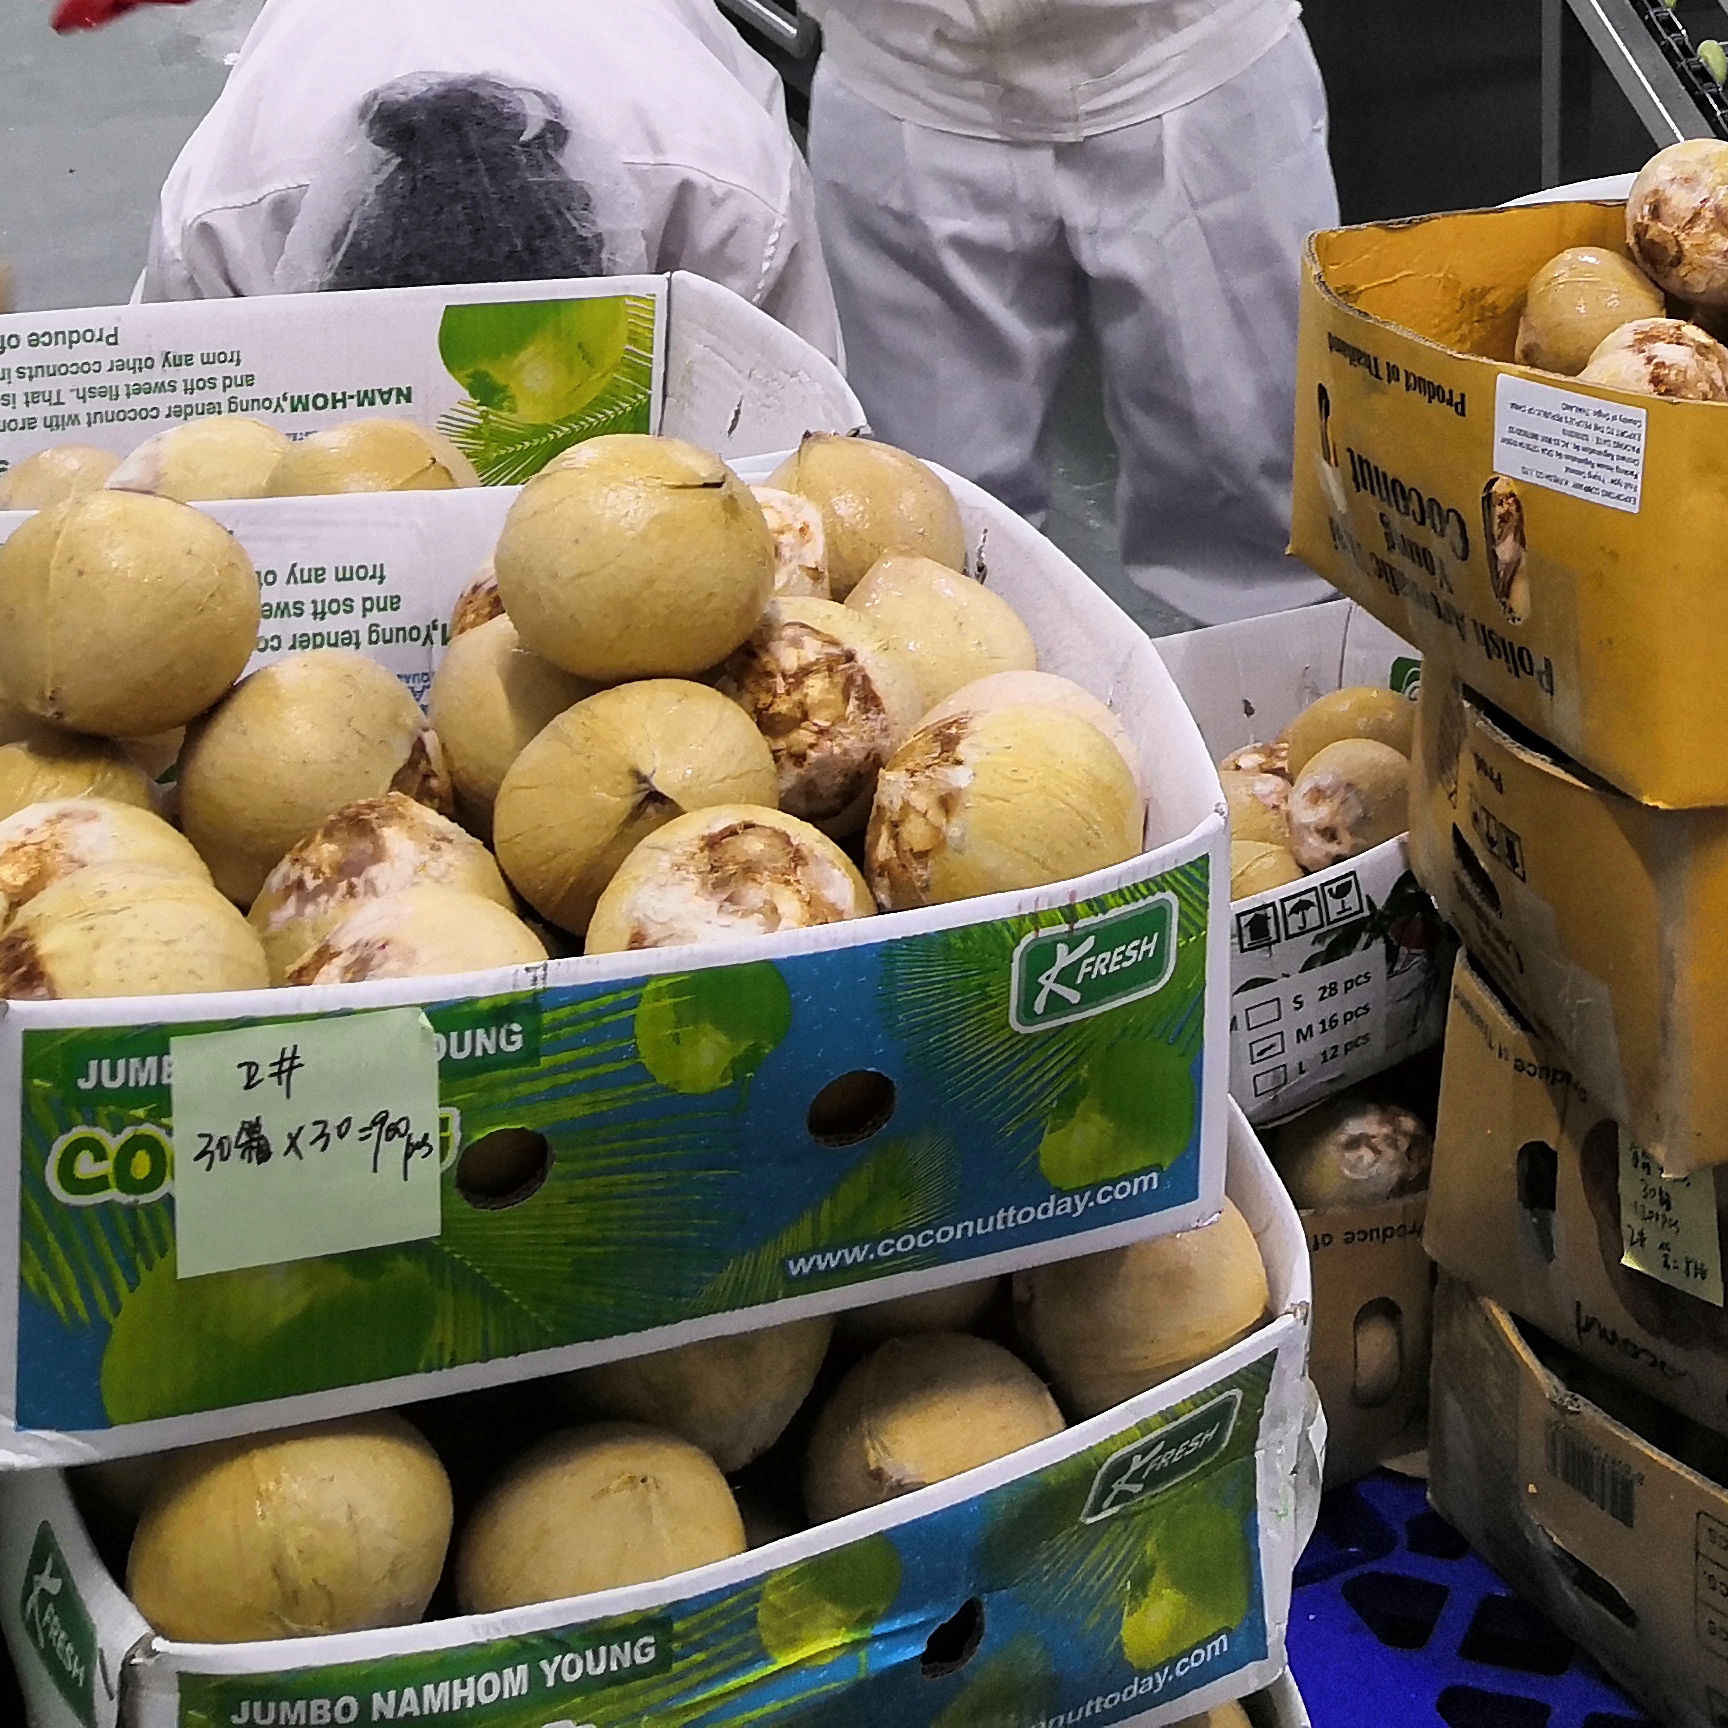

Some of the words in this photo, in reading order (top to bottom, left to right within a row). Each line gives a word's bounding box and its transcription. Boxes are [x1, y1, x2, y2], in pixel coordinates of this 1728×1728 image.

[27, 326, 119, 350] Produce
[16, 359, 102, 382] coconuts
[106, 356, 155, 374] other
[161, 350, 196, 370] any
[200, 350, 242, 368] from
[124, 379, 178, 399] sweet
[183, 376, 218, 397] soft
[221, 373, 256, 390] and
[0, 393, 17, 410] is
[24, 388, 66, 408] That
[1404, 369, 1466, 418] Product
[86, 405, 161, 428] coconut
[165, 399, 223, 419] tender
[42, 413, 82, 432] with
[1345, 446, 1470, 561] Coconut
[1378, 512, 1455, 594] Young
[285, 562, 327, 585] any
[334, 563, 387, 586] from
[311, 596, 355, 621] soft
[361, 594, 402, 619] and
[287, 629, 361, 651] tender
[1033, 934, 1096, 1015] K
[1075, 931, 1159, 985] FRESH
[1293, 994, 1305, 1012] S
[1318, 981, 1338, 1003] 28
[1343, 971, 1372, 995] pcs
[1295, 1028, 1314, 1045] M
[1319, 1014, 1339, 1035] 16
[1343, 1002, 1371, 1025] pcs
[1320, 1044, 1339, 1065] 12
[1343, 1032, 1371, 1055] pcs
[786, 1171, 1160, 1277] www.coconuttoday.com
[1102, 1440, 1166, 1509] K
[1142, 1422, 1220, 1479] FRESH
[41, 1603, 87, 1688] FRESH
[229, 1693, 359, 1727] JUMBO
[370, 1659, 530, 1723] NAMHOM
[538, 1635, 657, 1689] YOUNG
